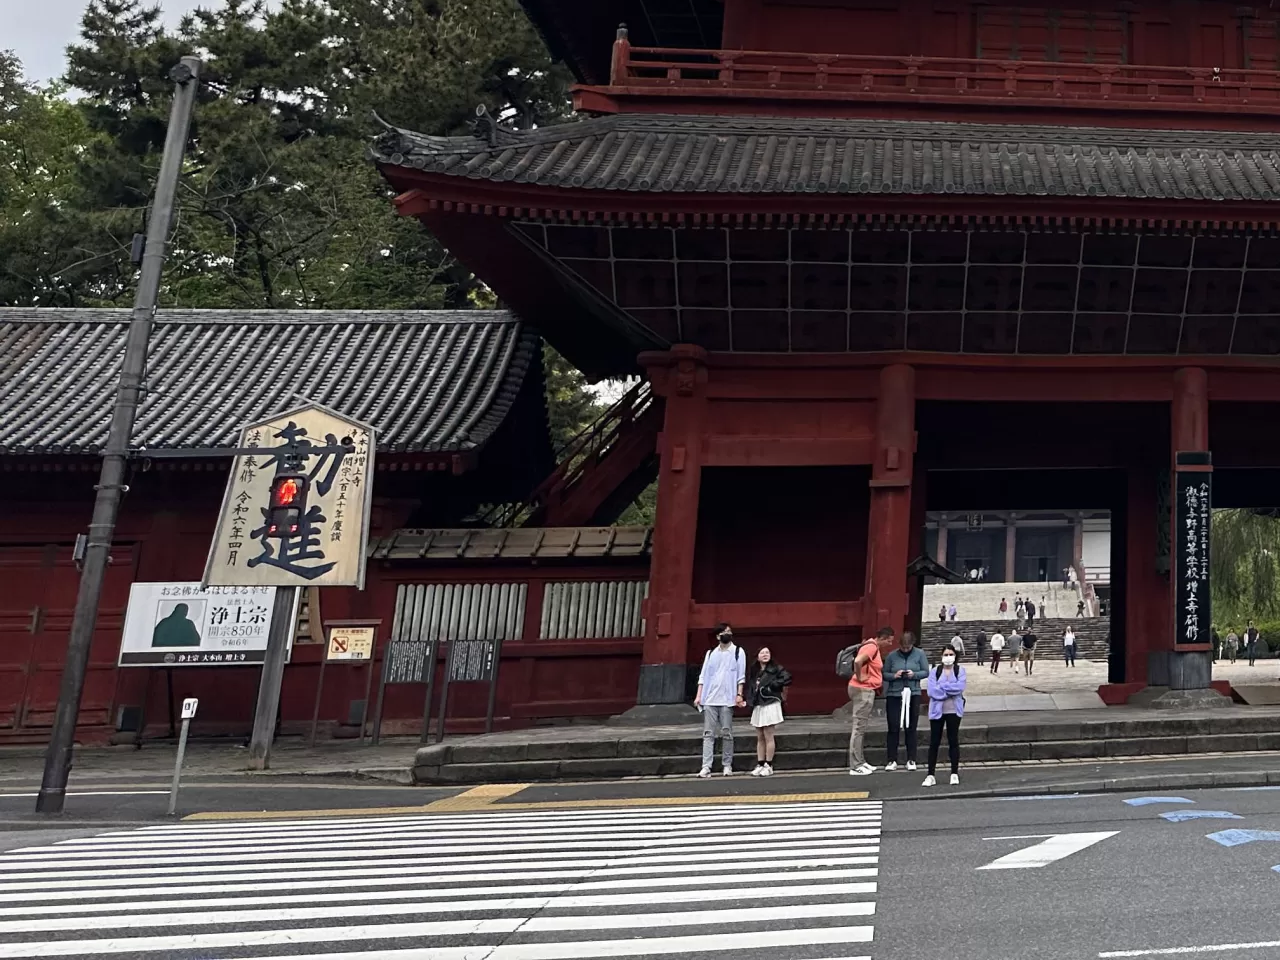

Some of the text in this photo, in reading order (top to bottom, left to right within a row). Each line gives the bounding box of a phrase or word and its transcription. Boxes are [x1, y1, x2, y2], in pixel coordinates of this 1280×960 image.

[210, 606, 268, 625] 浄土宗
[208, 625, 264, 637] 開宗850年
[178, 653, 246, 662] 浄土宗 大本山 増上寺
